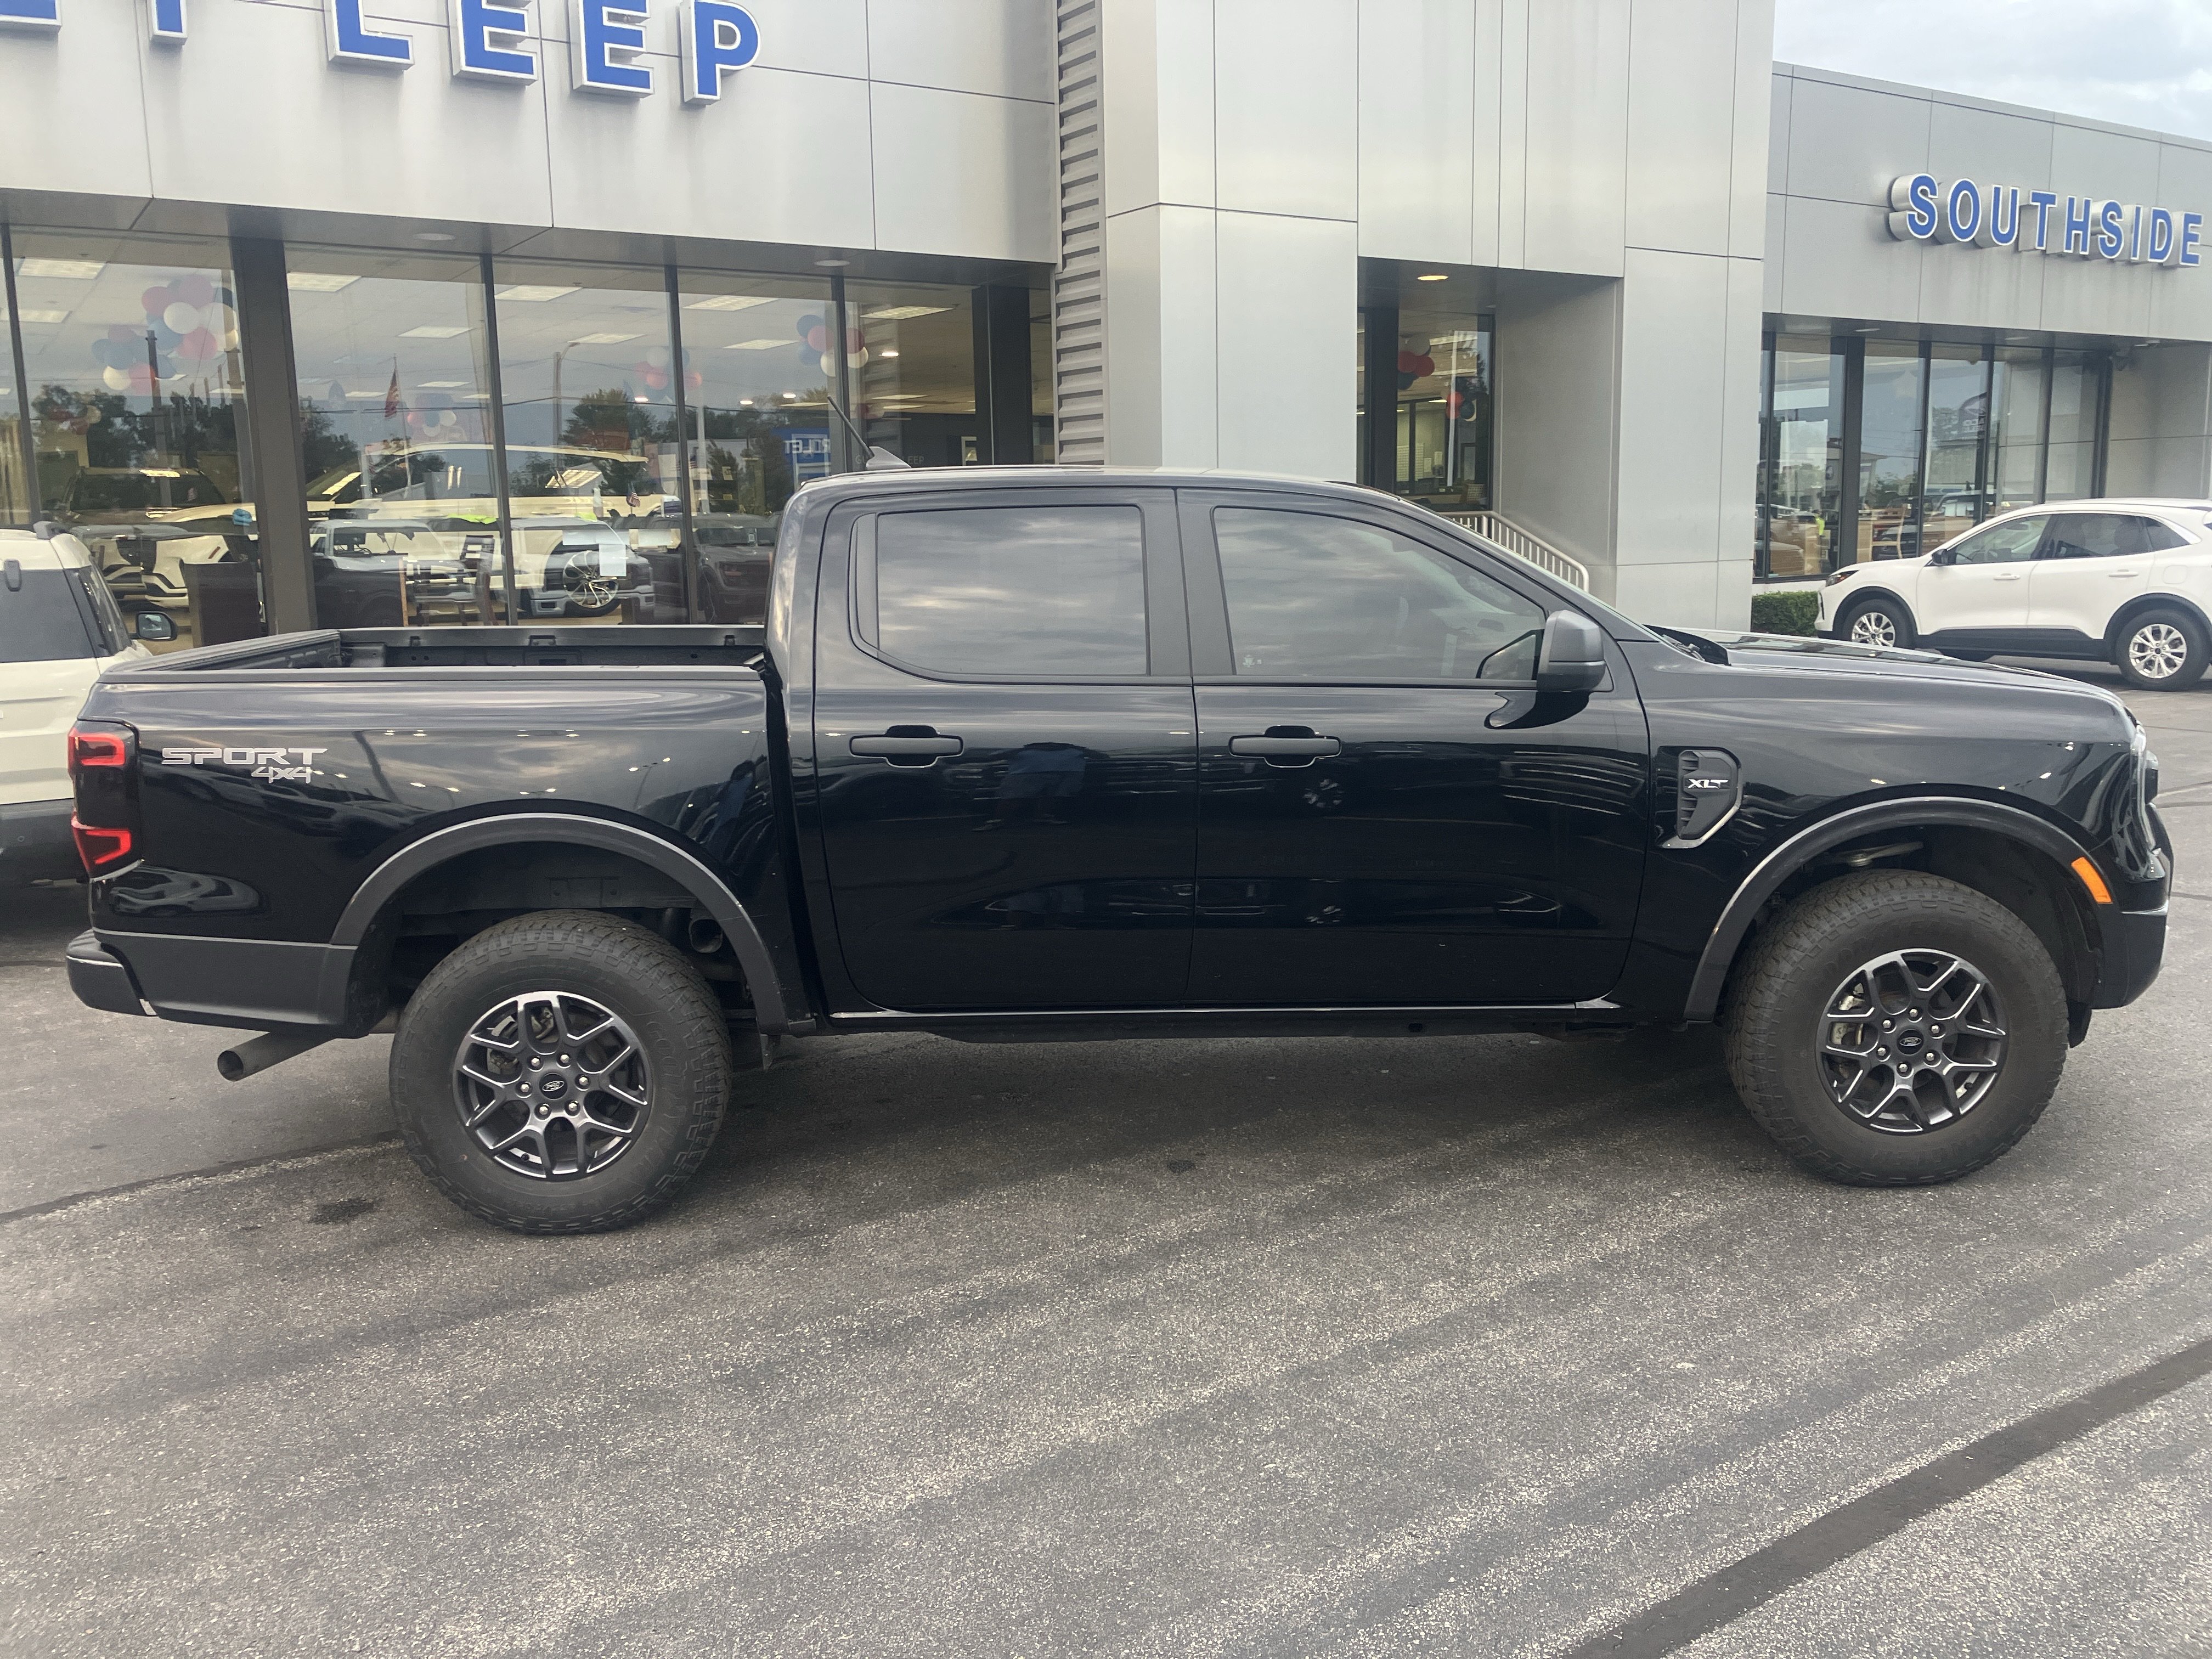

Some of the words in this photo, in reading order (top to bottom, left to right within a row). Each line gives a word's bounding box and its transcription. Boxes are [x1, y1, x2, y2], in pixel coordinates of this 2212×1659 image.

[330, 0, 761, 104] LEEP
[1903, 172, 2204, 267] SOUTHSIDE
[161, 747, 328, 765] SPORT
[251, 766, 312, 783] 4x4
[1688, 778, 1729, 789] XLT
